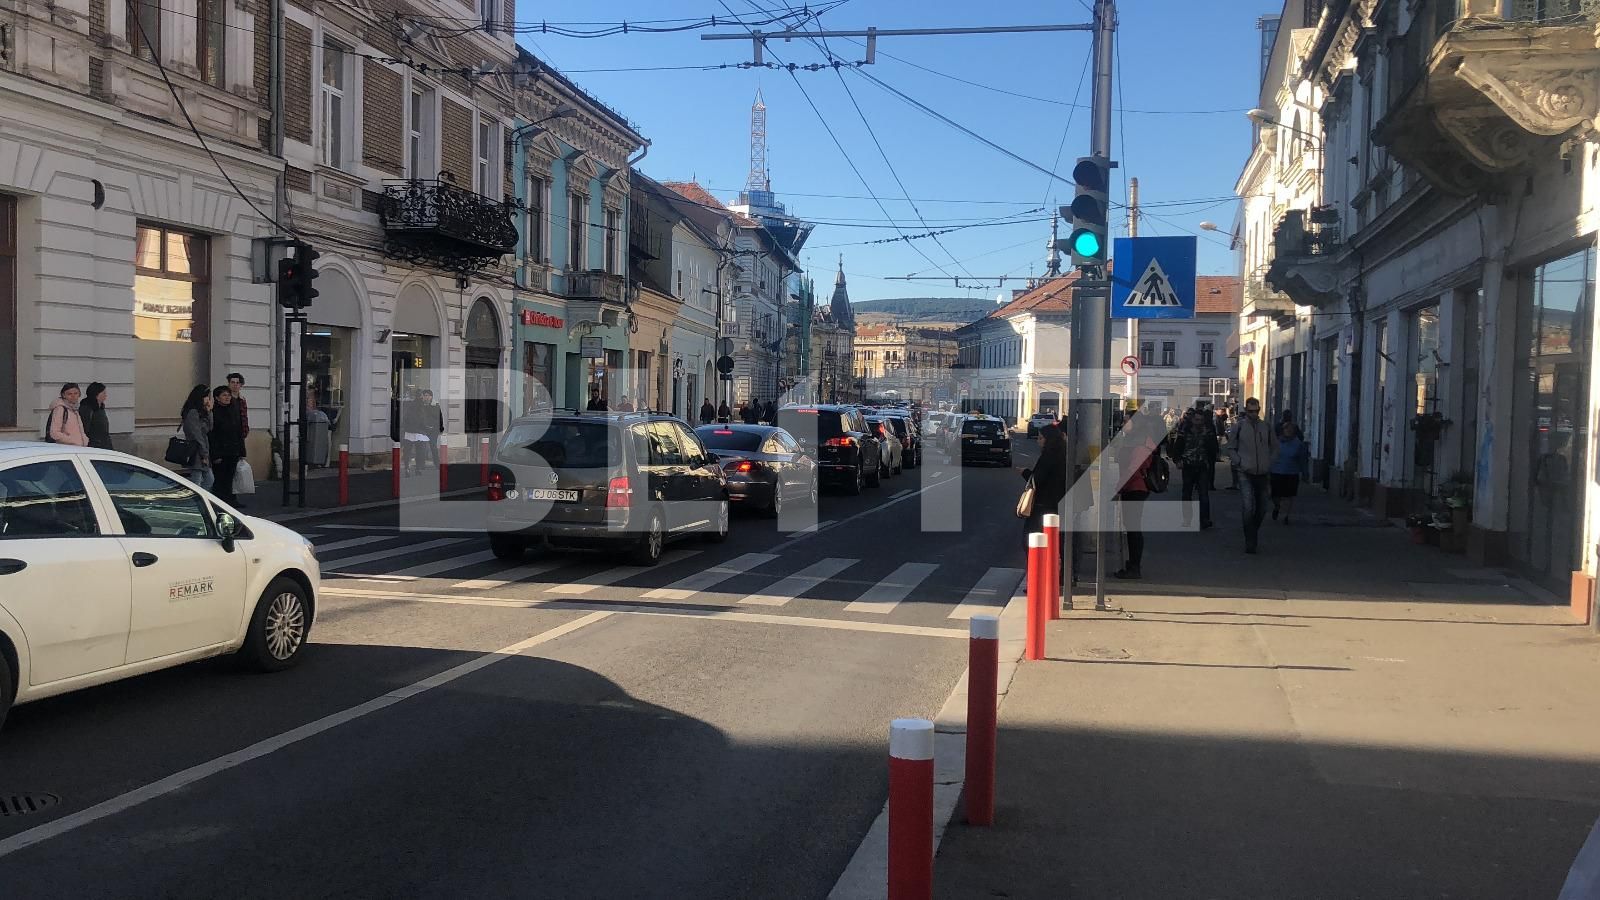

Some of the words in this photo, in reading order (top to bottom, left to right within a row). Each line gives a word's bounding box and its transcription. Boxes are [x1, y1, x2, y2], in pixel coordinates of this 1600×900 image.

[534, 490, 545, 499] CJ
[546, 490, 557, 499] 06
[558, 490, 576, 500] STK
[169, 582, 214, 598] REMARK
